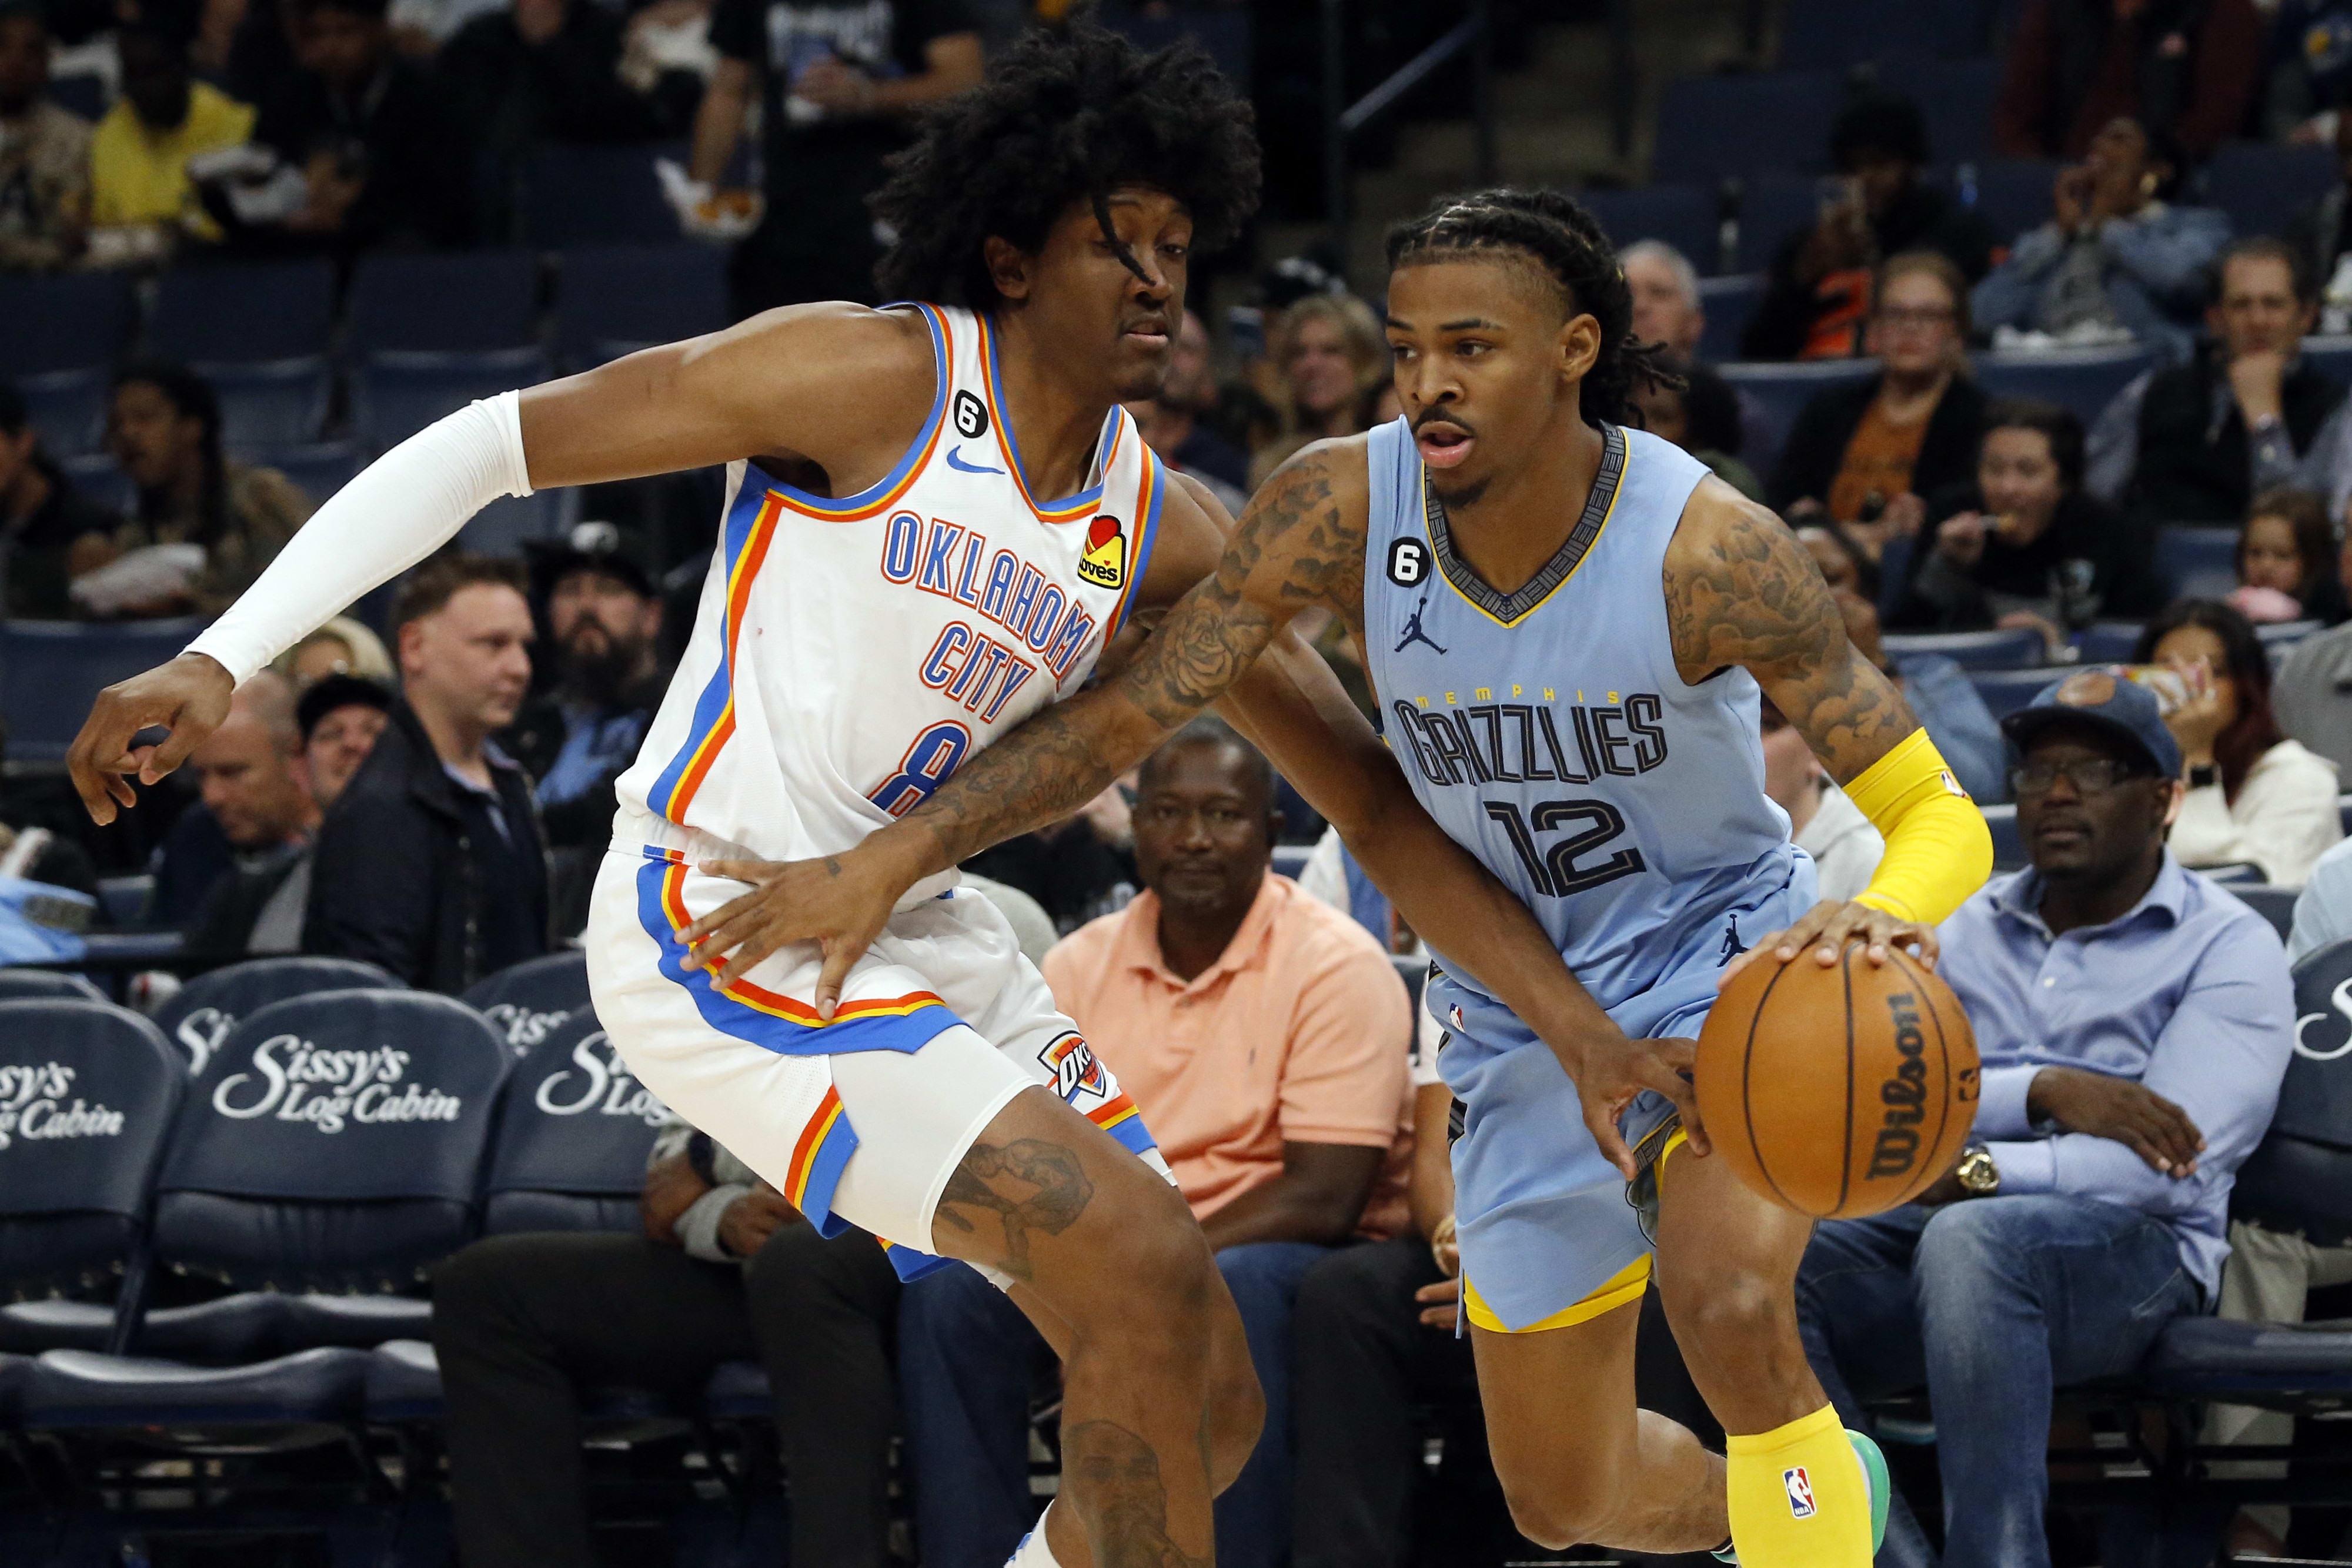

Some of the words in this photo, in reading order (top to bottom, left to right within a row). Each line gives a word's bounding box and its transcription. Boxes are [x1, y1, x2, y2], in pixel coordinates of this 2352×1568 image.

[957, 396, 980, 433] 6
[880, 510, 1098, 683] OKLAHOM
[1394, 544, 1421, 581] 6
[918, 620, 1037, 724] CITY
[864, 718, 972, 822] 8
[1394, 693, 1668, 787] GRIZZLIES
[1482, 799, 1647, 898] 12
[212, 1034, 410, 1119] Sissy's
[276, 1082, 352, 1135] Log
[353, 1082, 462, 1123] Cabin
[1058, 1041, 1092, 1099] OKC
[1864, 992, 1927, 1181] Wilson
[19, 1098, 125, 1140] Cabin
[1794, 1506, 1811, 1516] NBA
